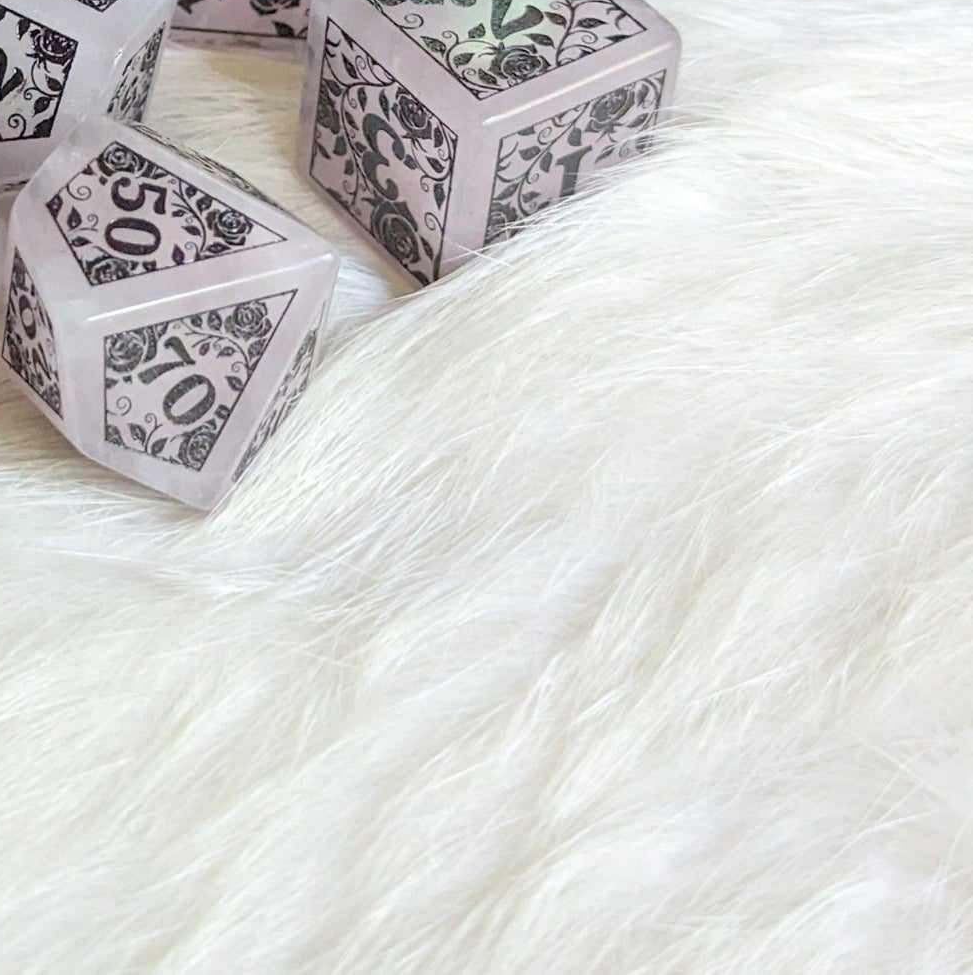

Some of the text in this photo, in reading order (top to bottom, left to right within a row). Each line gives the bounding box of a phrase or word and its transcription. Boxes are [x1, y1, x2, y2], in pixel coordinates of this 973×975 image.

[362, 113, 405, 202] 3
[555, 145, 592, 197] 1
[105, 177, 167, 256] 50
[137, 336, 216, 426] 70
